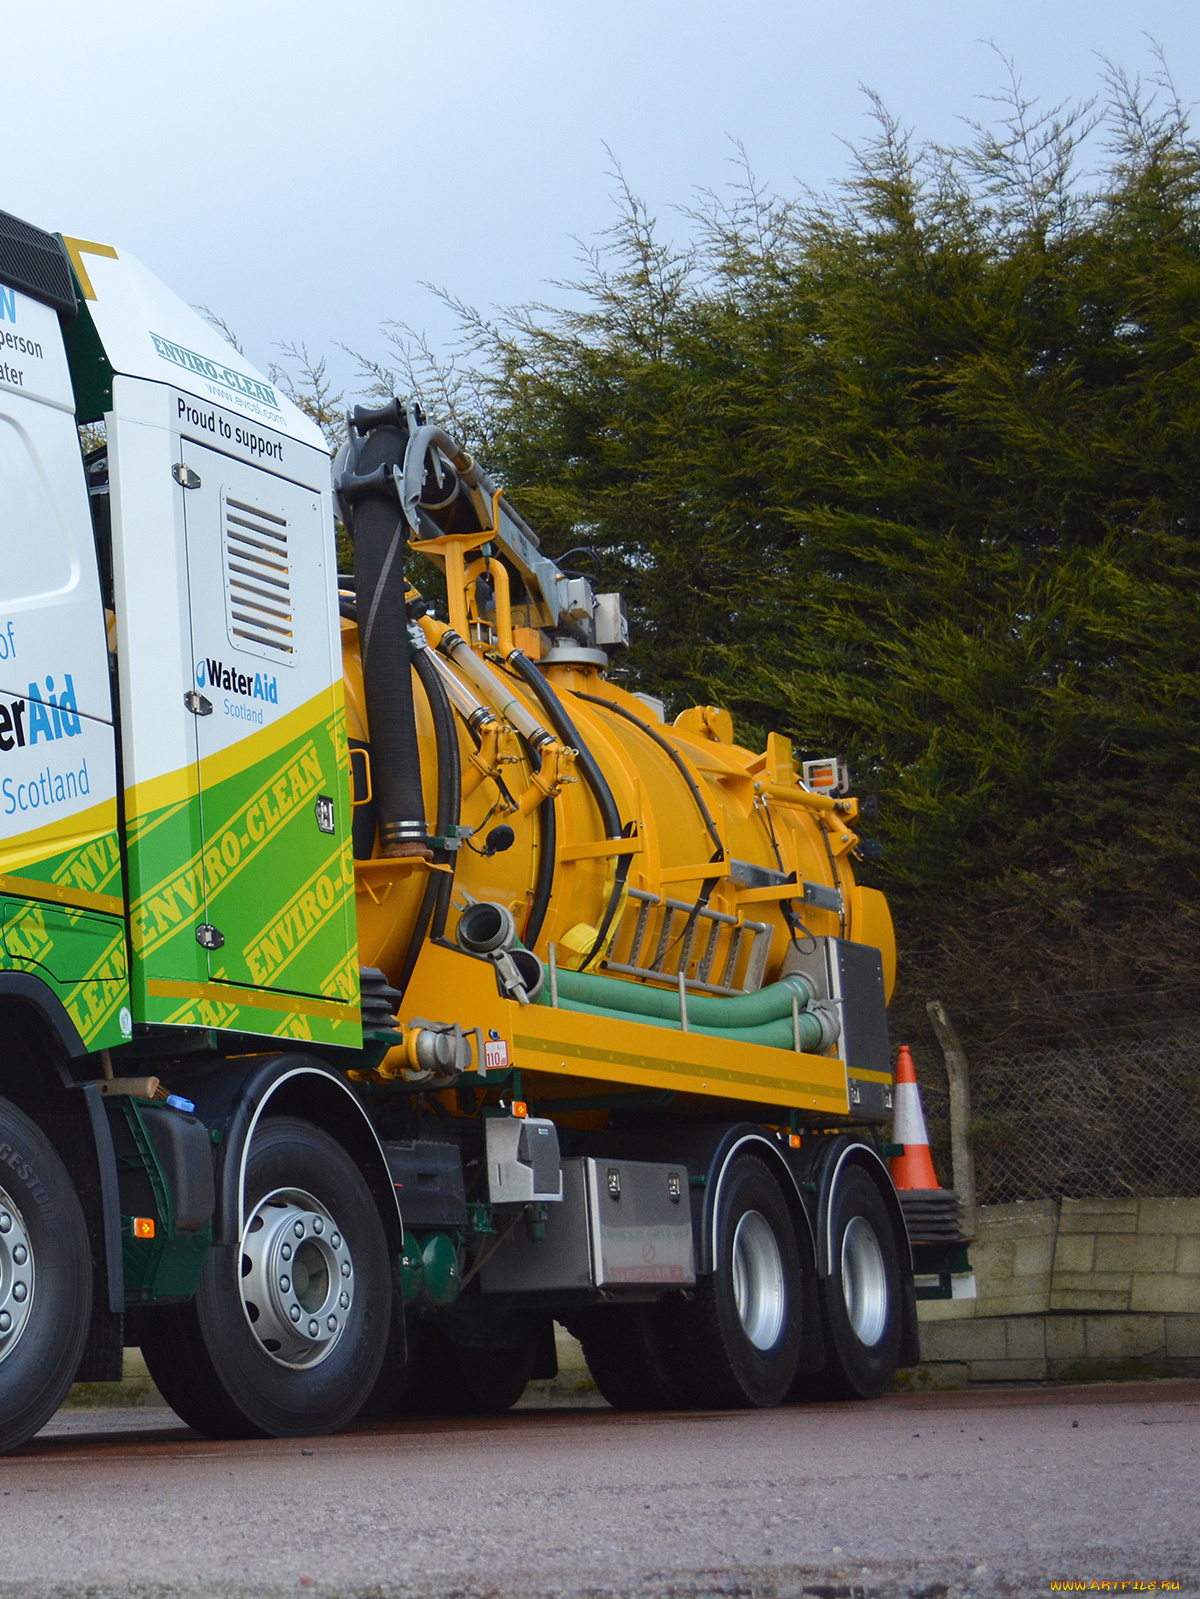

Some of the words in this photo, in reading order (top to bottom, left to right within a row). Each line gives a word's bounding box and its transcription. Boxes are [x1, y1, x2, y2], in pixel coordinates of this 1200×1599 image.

[150, 333, 280, 408] ENVIRO-CLEAN
[177, 397, 215, 433] Proud
[218, 416, 232, 440] to
[235, 428, 284, 462] support
[205, 657, 279, 705] WaterAid
[223, 698, 264, 725] Scotland
[1, 757, 91, 815] Scotland
[130, 745, 324, 952] ENVIRO-CLEAN
